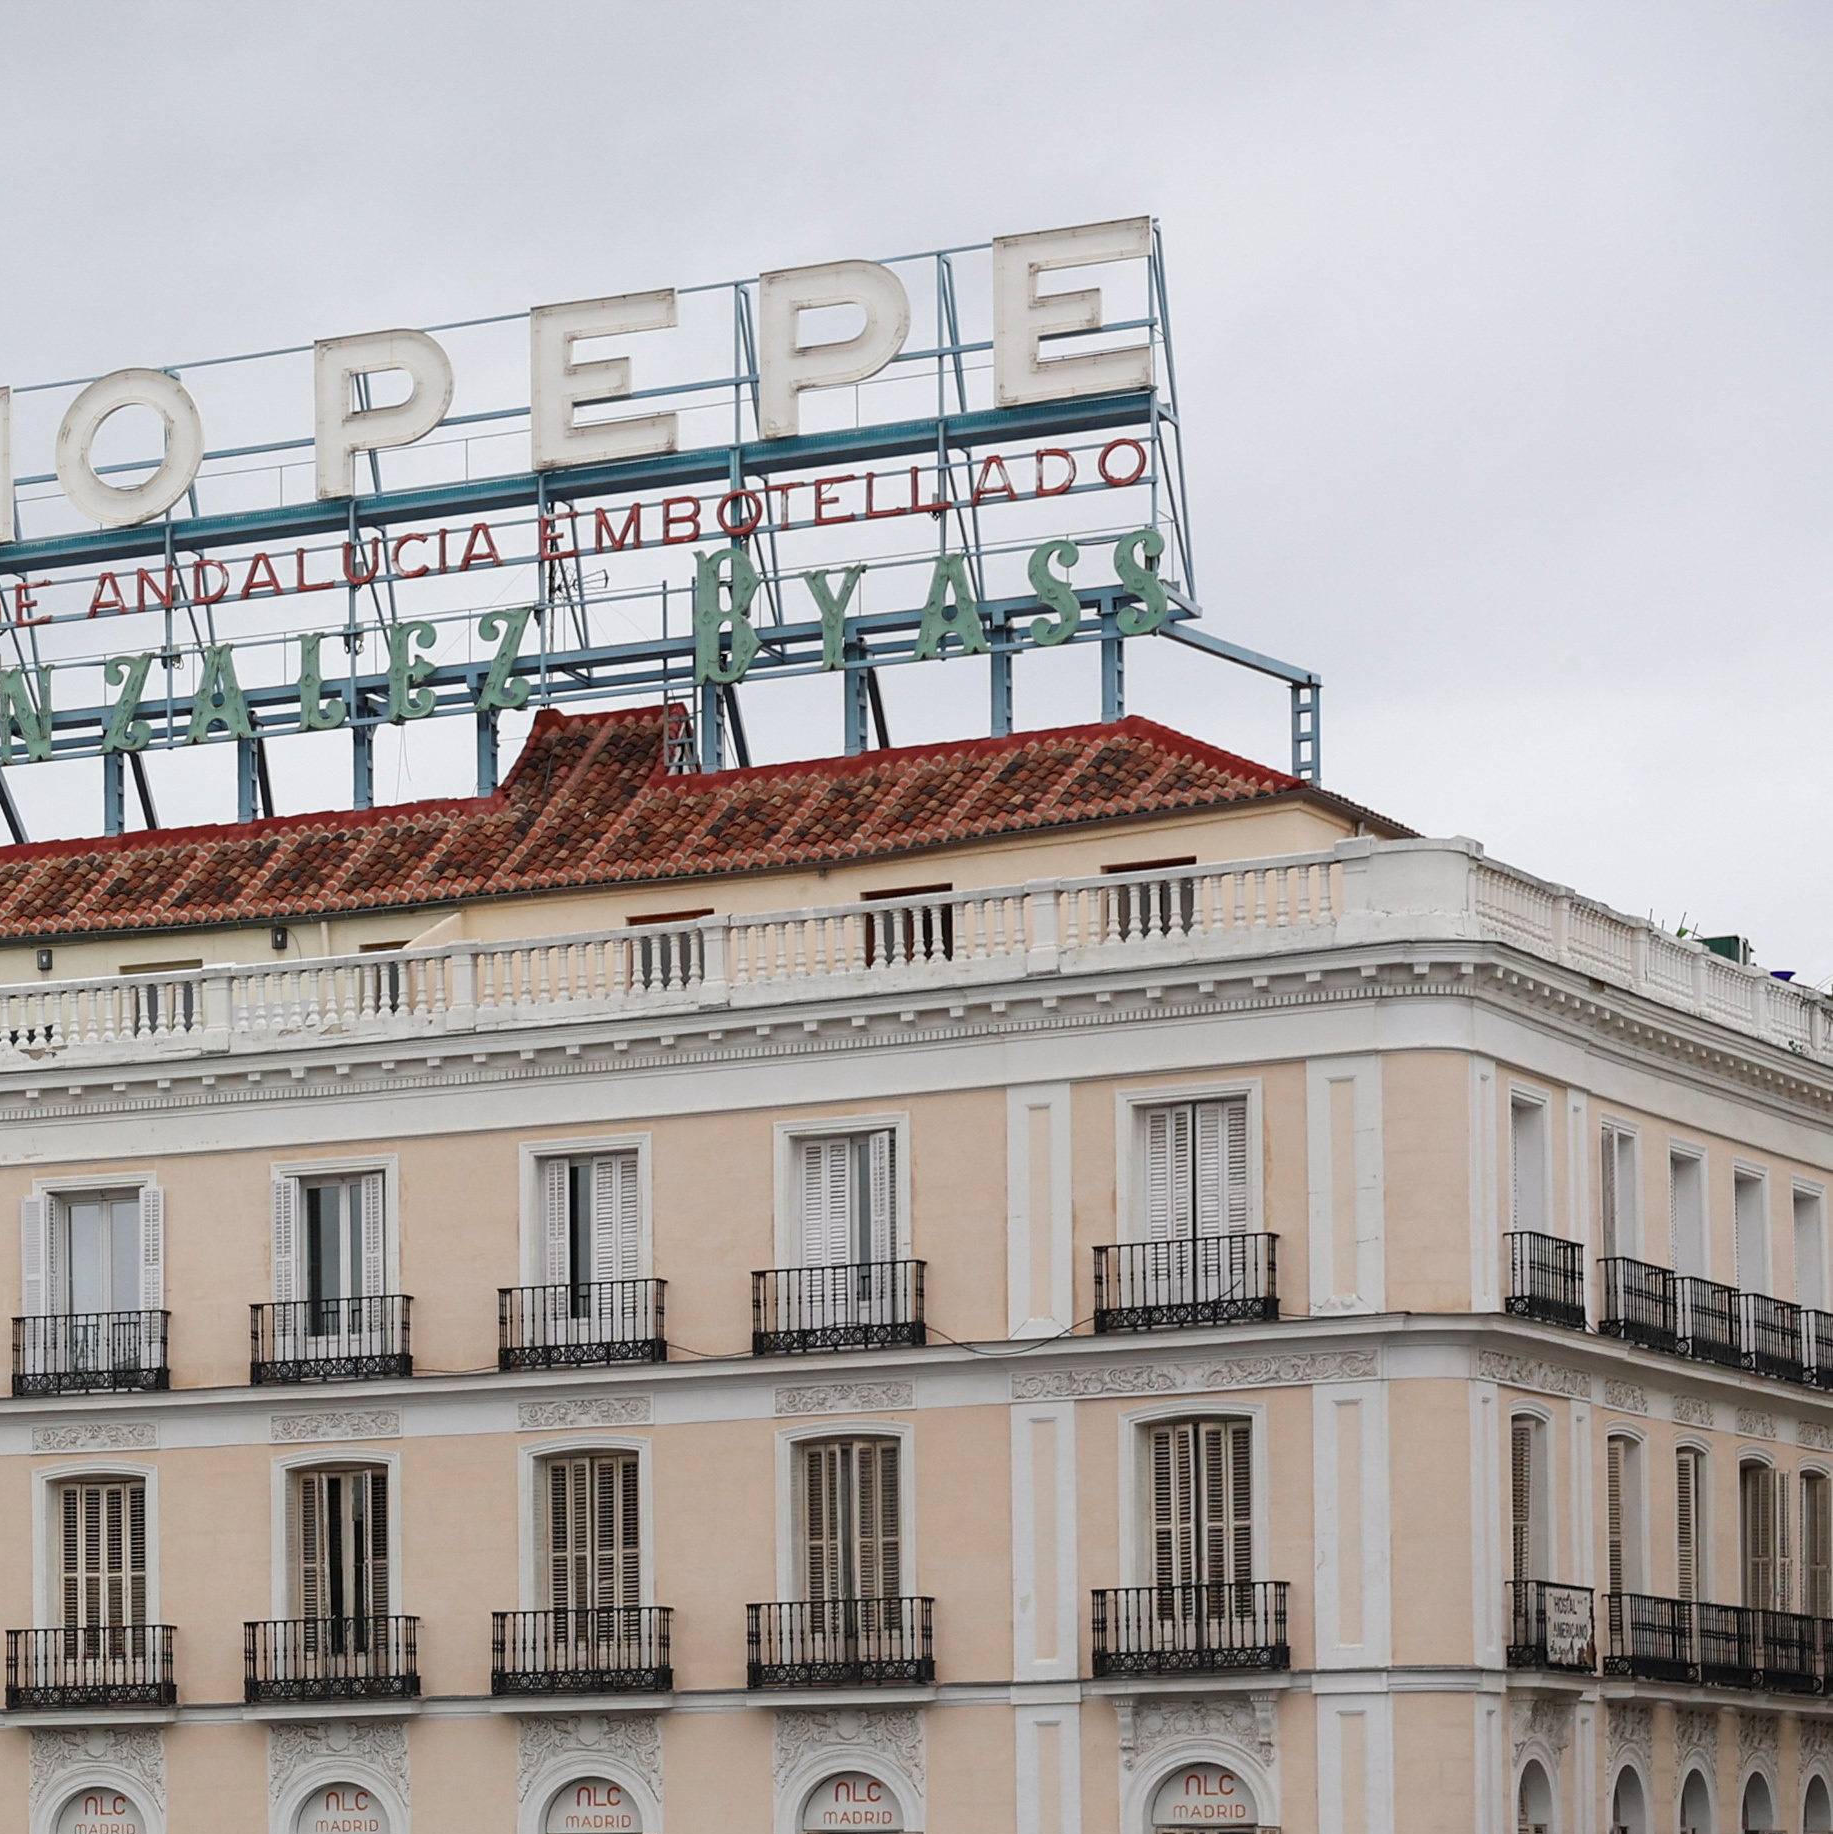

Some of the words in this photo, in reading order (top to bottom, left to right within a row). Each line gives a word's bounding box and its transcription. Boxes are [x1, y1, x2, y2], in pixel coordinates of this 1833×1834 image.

[314, 216, 1151, 501] PEPE
[87, 523, 503, 618] ANDALUCIA
[540, 438, 1147, 559] EMBOTELLADO
[692, 528, 1168, 686] BYASS
[835, 1781, 882, 1802] NLC
[1185, 1774, 1234, 1796] NLC
[84, 1796, 126, 1816] NLC
[325, 1791, 369, 1811] NLC
[577, 1787, 621, 1807] NLC
[566, 1815, 632, 1828] MADRID
[823, 1810, 892, 1824] MADRID
[1173, 1804, 1246, 1819] MADRID
[315, 1819, 379, 1832] MADRID
